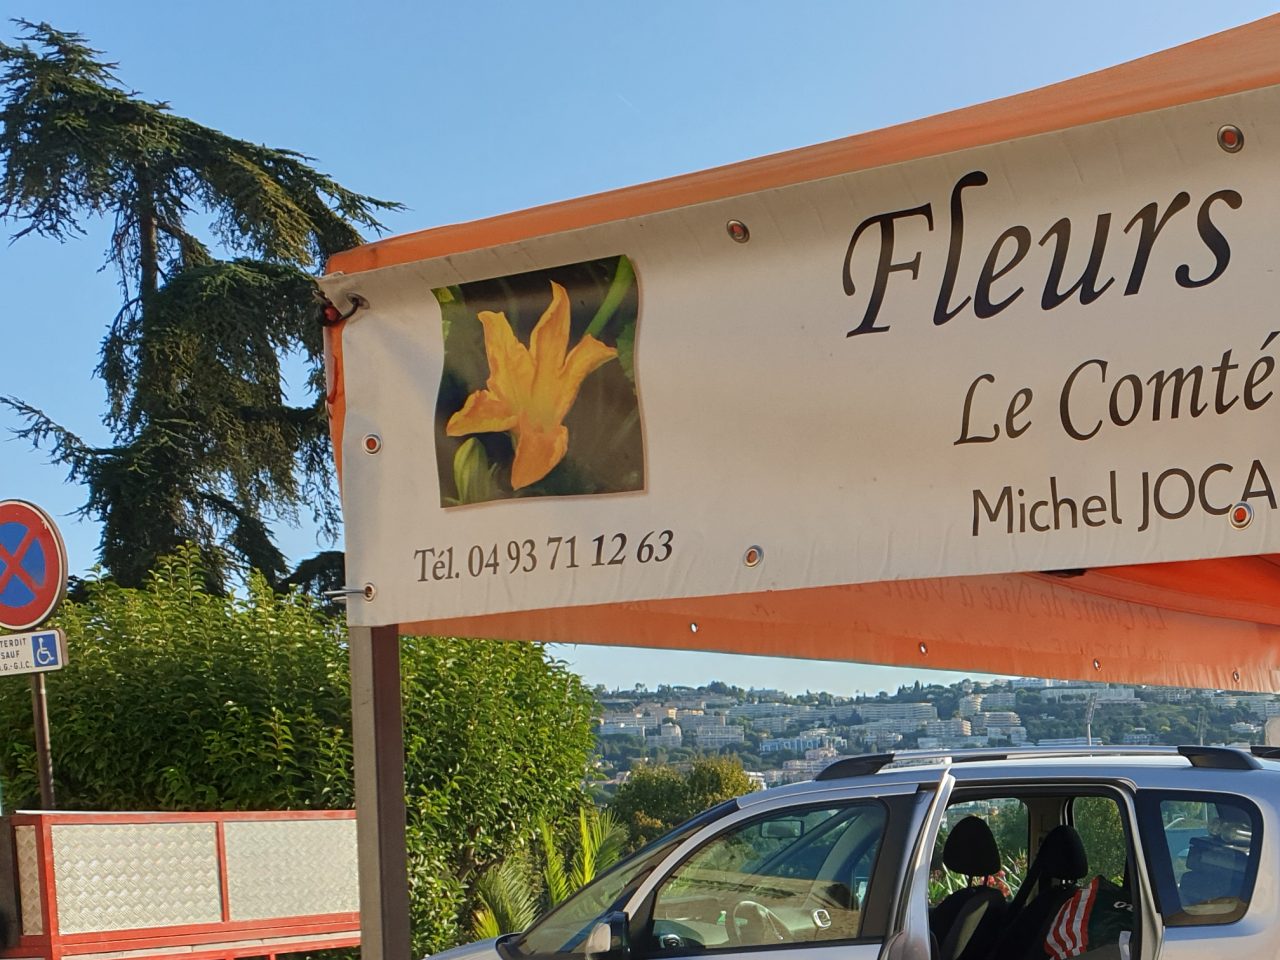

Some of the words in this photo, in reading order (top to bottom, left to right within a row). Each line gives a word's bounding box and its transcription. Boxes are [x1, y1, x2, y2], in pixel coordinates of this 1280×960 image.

[843, 171, 1242, 338] Fleurs
[954, 373, 1033, 445] Le
[1060, 331, 1280, 440] Comté
[972, 476, 1122, 536] Michel
[414, 546, 460, 582] Tél.
[547, 535, 579, 570] 71
[592, 532, 627, 566] 12
[637, 529, 674, 563] 63
[0, 650, 20, 660] SAUF
